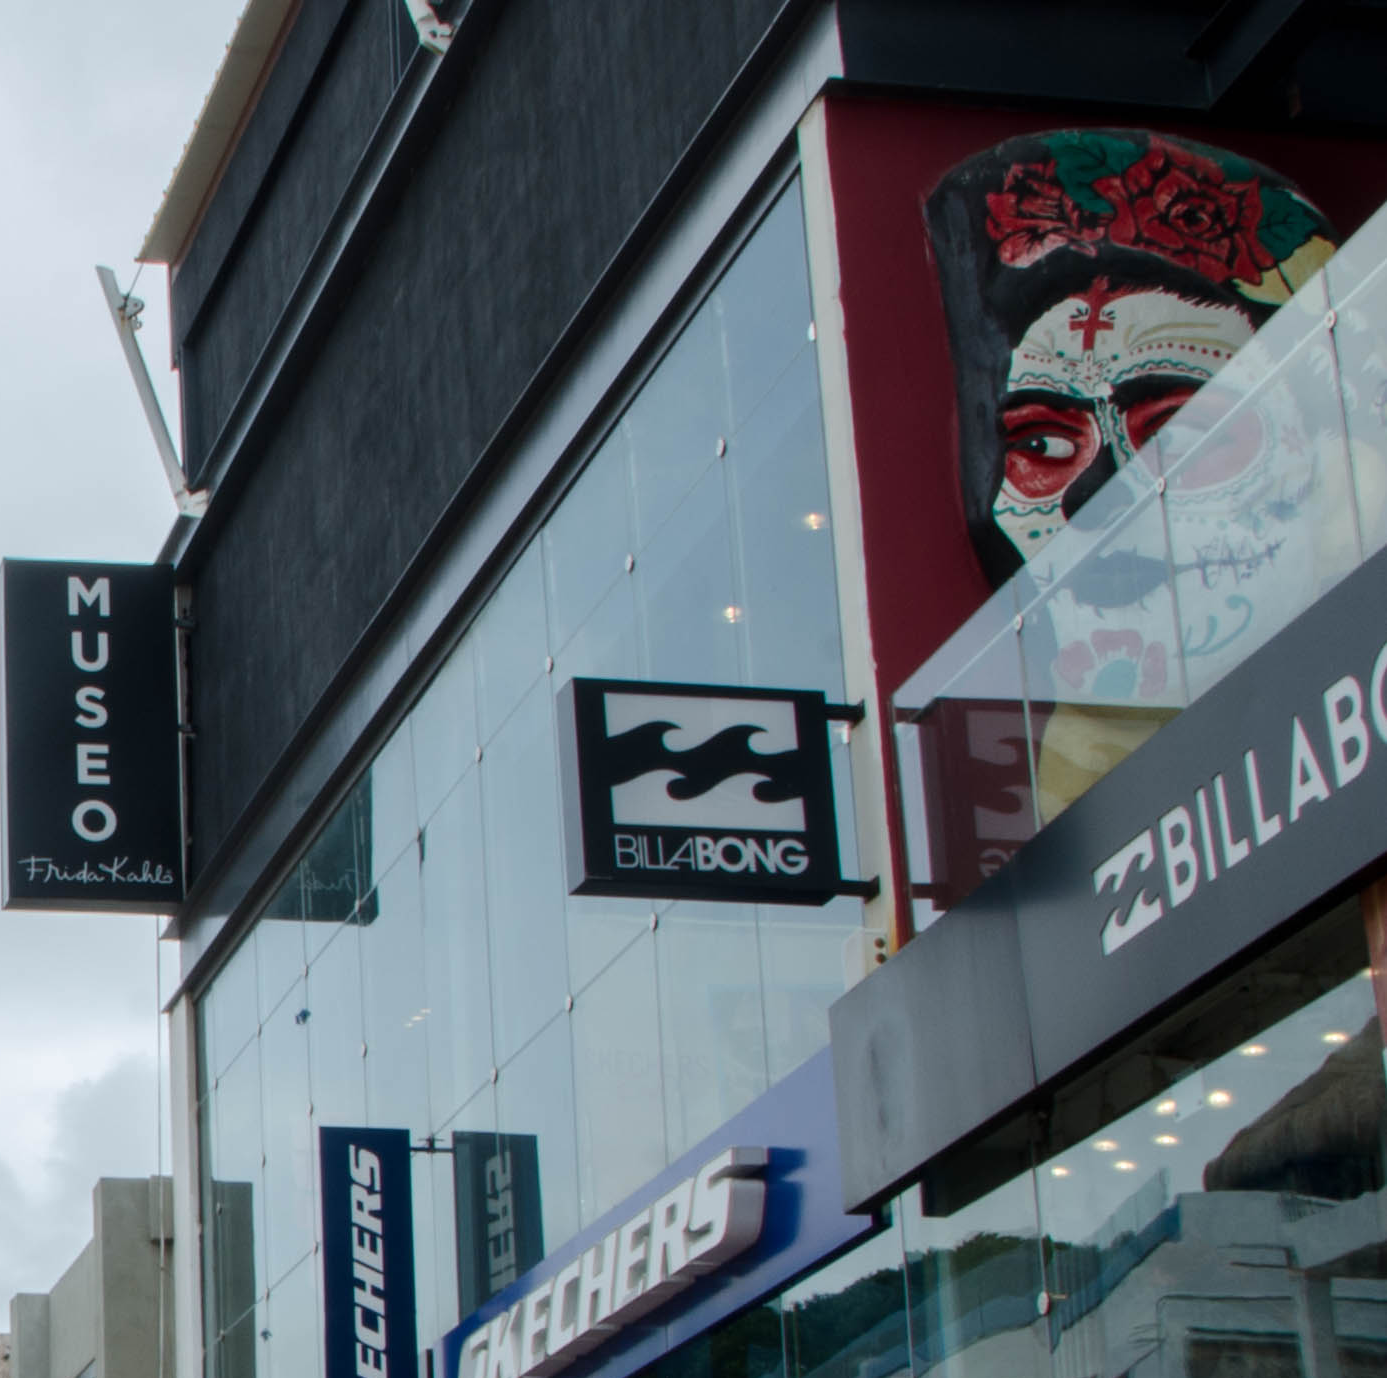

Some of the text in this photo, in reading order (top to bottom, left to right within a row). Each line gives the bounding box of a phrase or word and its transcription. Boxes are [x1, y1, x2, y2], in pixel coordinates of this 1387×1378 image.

[67, 575, 118, 844] MUSEO
[17, 855, 174, 885] Frida Kahlo
[612, 833, 811, 877] BILLABONG
